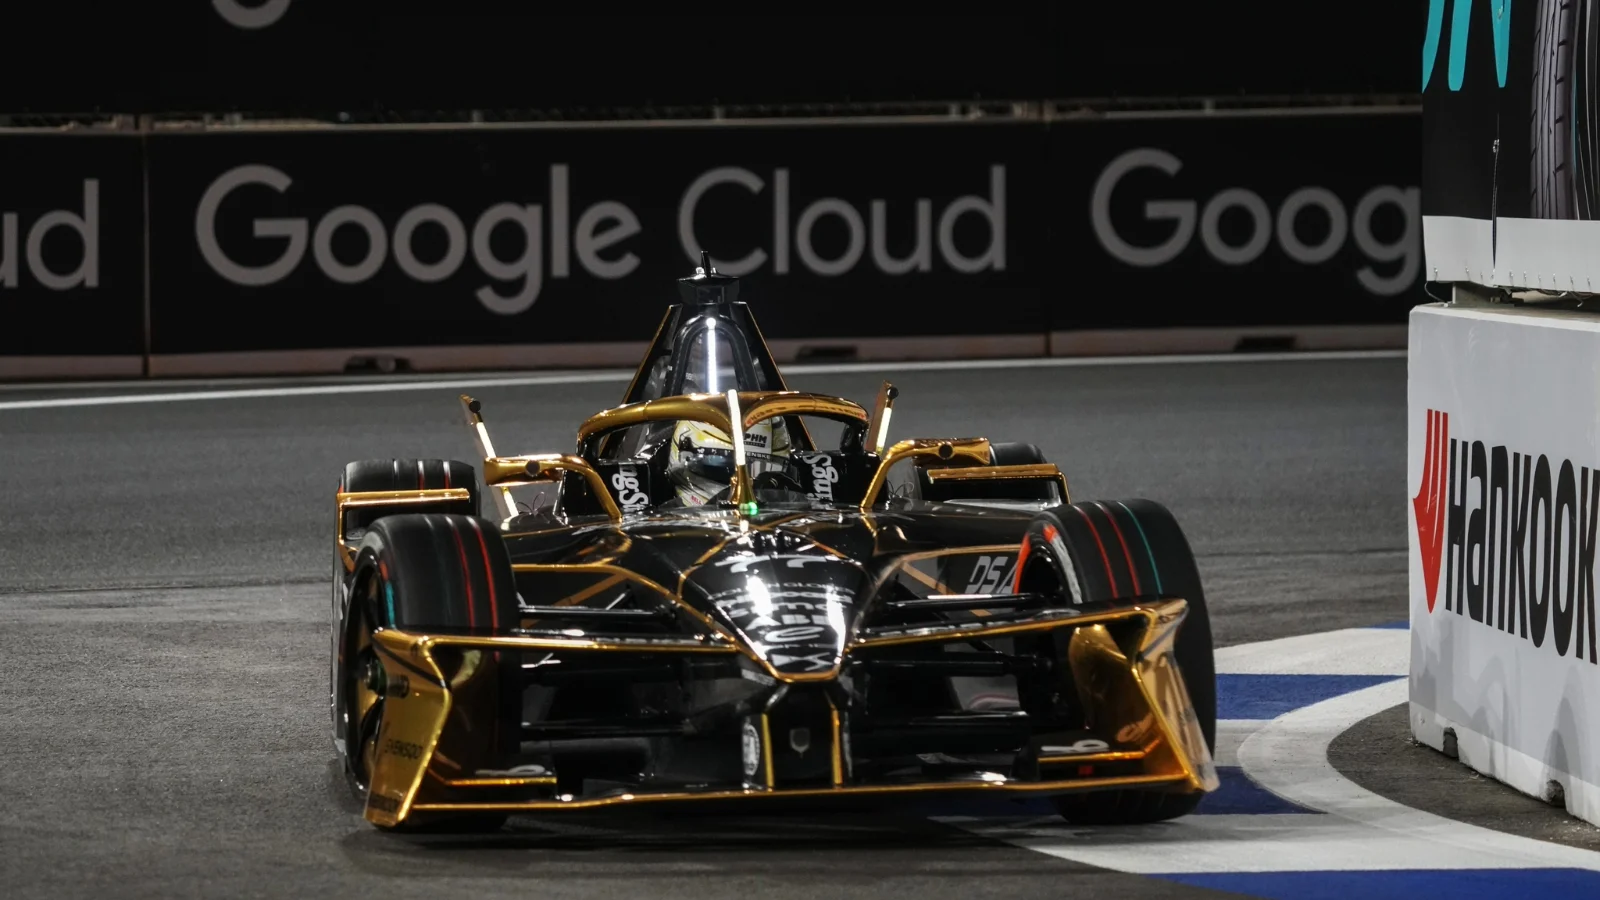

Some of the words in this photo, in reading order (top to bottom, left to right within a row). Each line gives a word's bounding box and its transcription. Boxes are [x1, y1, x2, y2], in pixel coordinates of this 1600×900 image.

[195, 164, 642, 314] Google
[678, 164, 1007, 276] Cloud
[1090, 148, 1422, 296] Goog
[745, 452, 771, 460] ENSKE
